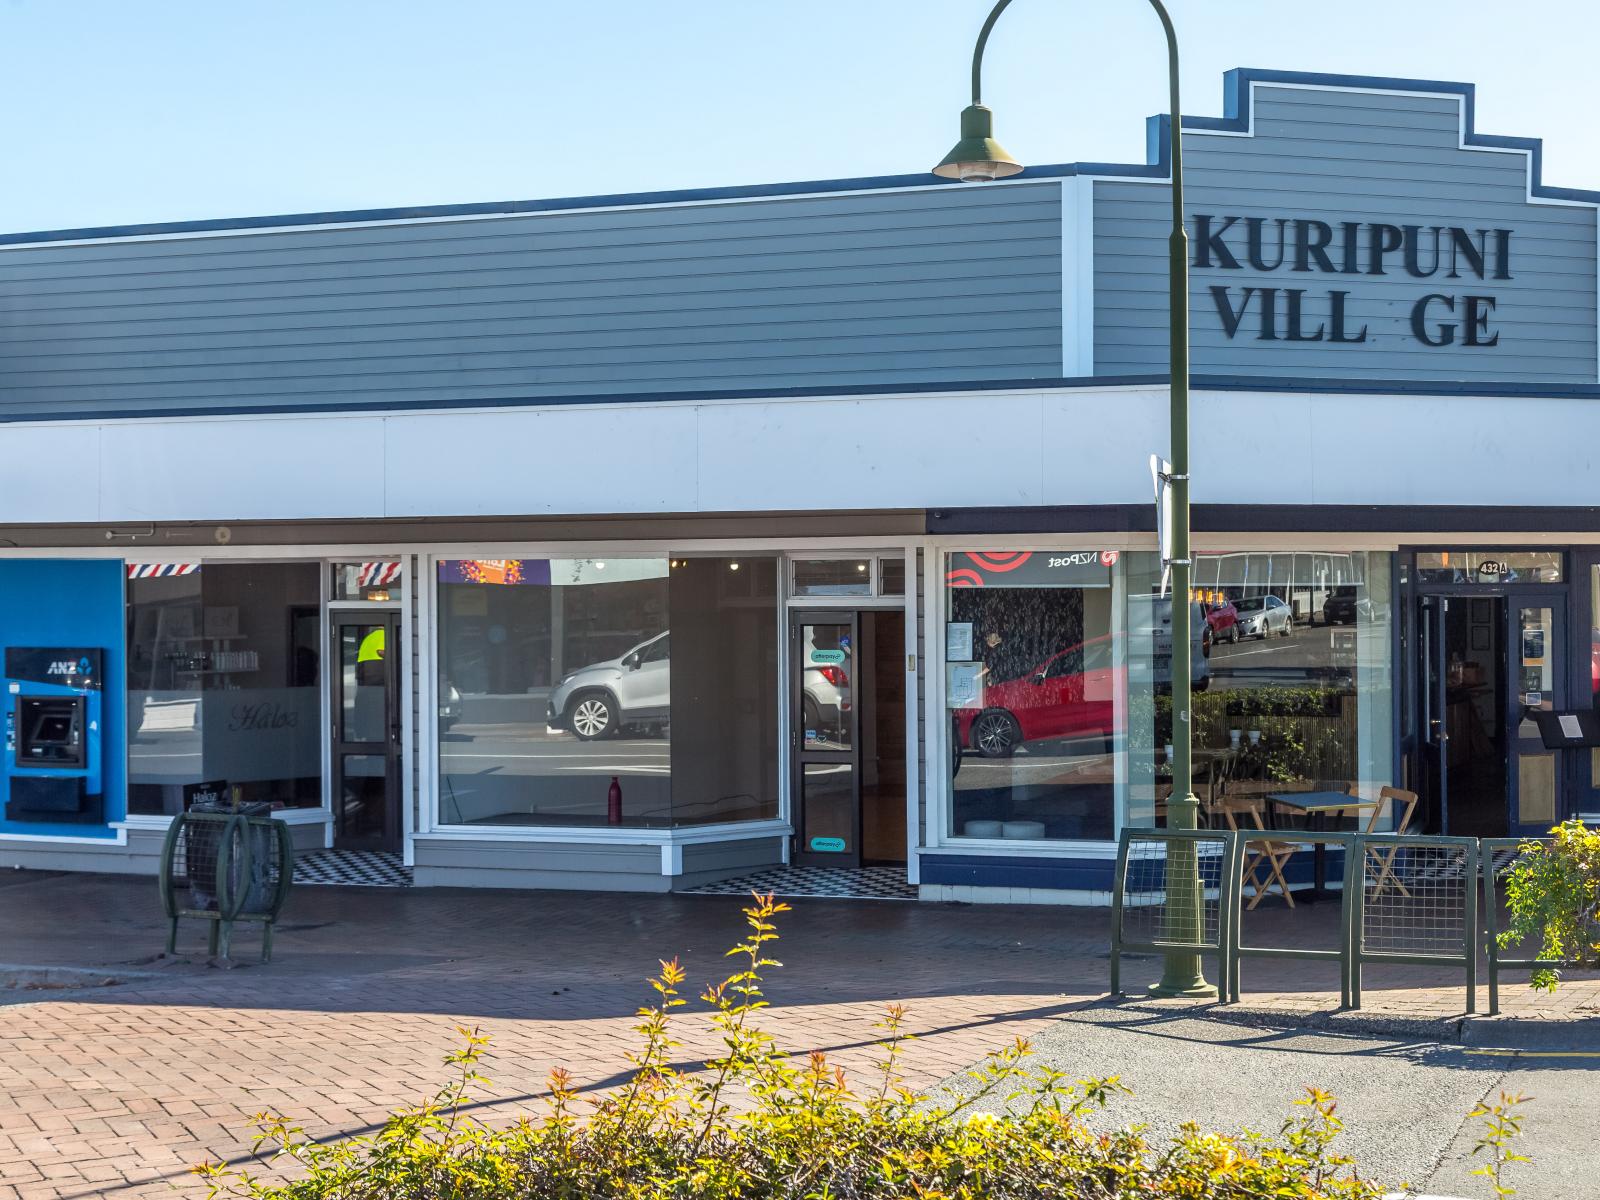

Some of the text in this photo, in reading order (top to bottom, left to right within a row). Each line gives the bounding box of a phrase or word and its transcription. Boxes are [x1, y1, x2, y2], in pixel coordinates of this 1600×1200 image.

[1192, 214, 1514, 280] KURIPUNI
[1208, 285, 1499, 347] VILLGE
[1480, 563, 1498, 573] 432
[47, 661, 77, 674] ANZ
